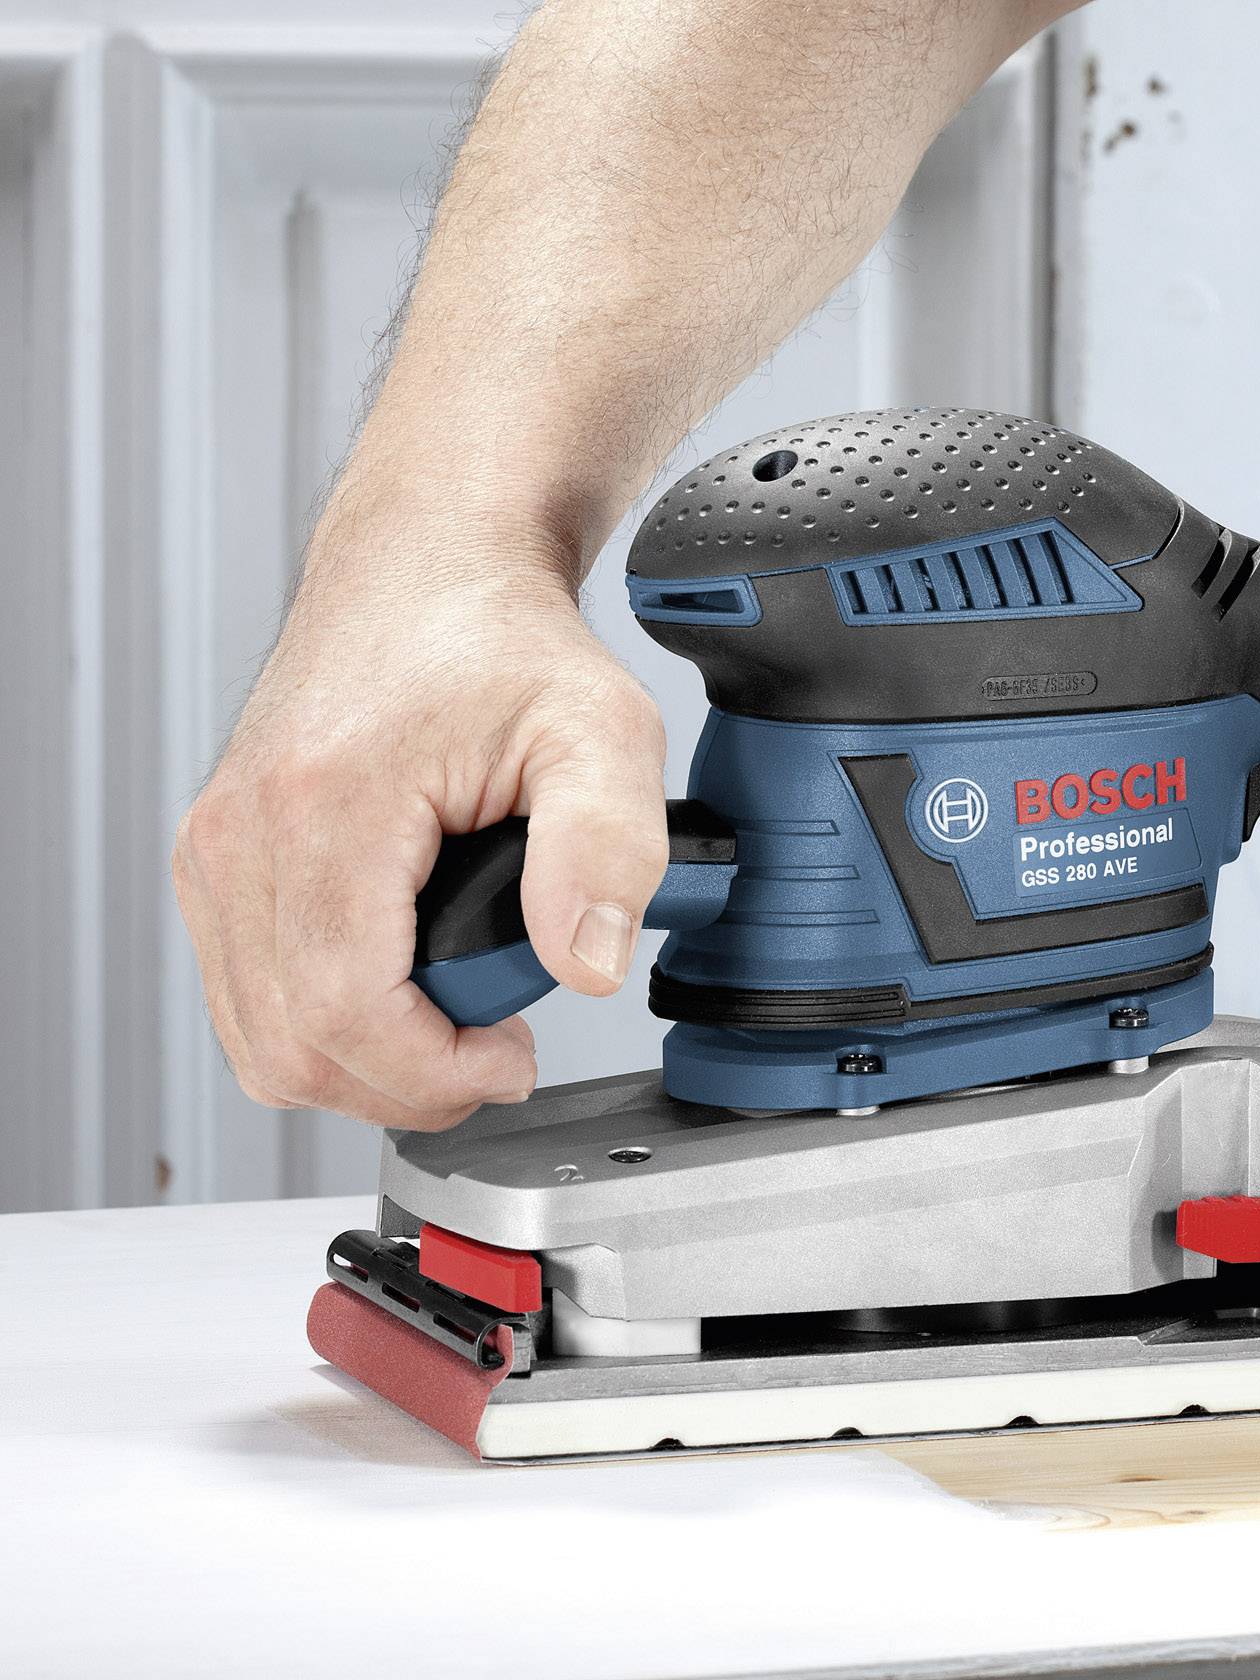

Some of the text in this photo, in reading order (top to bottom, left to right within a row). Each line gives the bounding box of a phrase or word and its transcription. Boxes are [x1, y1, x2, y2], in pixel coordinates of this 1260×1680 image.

[1015, 757, 1187, 825] BOSCH
[1020, 818, 1173, 861] Professional
[1021, 857, 1138, 887] GSS 280 AVE
